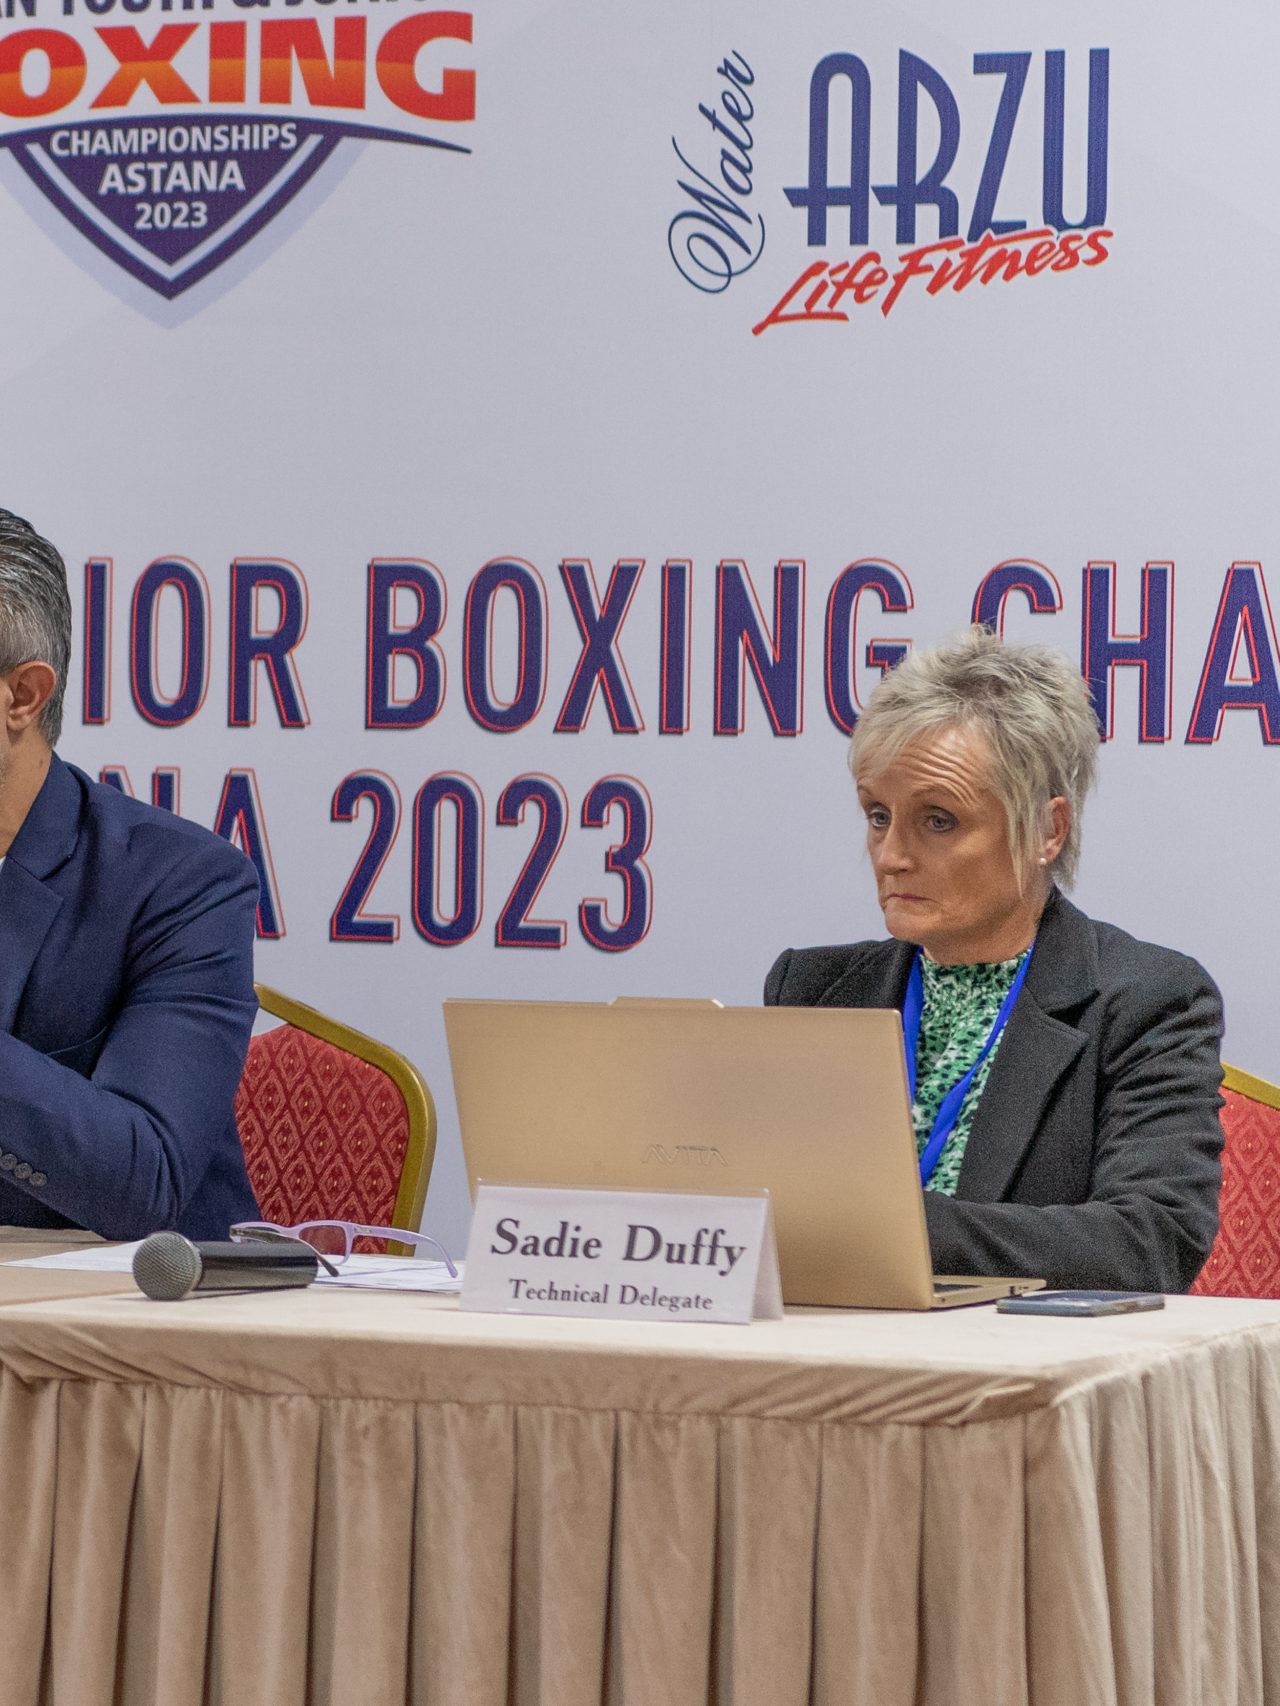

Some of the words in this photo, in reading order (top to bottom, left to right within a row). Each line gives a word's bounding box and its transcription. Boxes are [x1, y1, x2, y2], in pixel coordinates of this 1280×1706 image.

[51, 123, 298, 157] CHAMPIONSHIPS
[782, 48, 1110, 246] ARZU
[98, 160, 246, 195] ASTANA
[668, 50, 766, 294] Water
[134, 200, 209, 230] 2023
[365, 556, 915, 737] BOXING
[329, 769, 655, 951] 2023
[490, 1217, 602, 1260] Sadie
[622, 1224, 747, 1277] Duffy
[509, 1278, 609, 1305] Technical
[620, 1284, 713, 1312] Delegate
